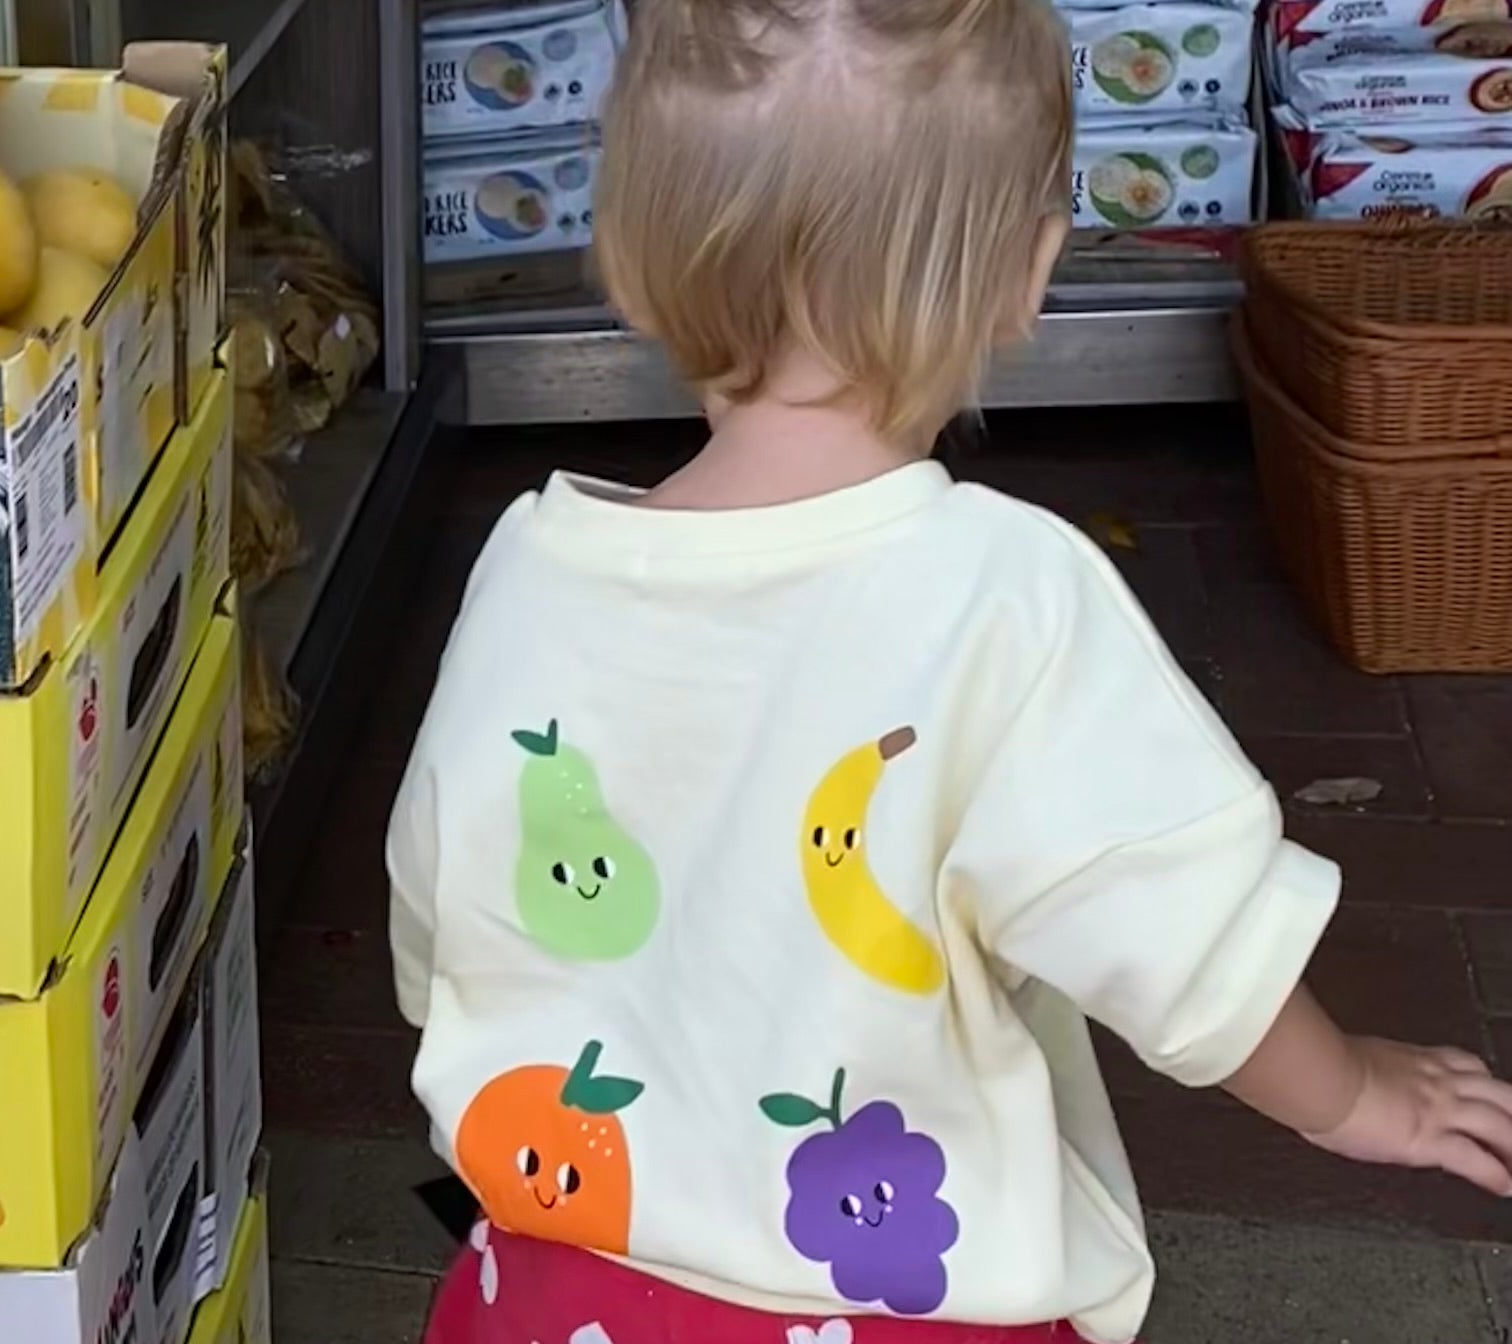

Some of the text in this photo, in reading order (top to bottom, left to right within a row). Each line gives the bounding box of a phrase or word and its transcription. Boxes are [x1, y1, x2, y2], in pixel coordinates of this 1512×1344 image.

[426, 61, 457, 81] RICE
[1371, 96, 1418, 109] BROWN
[1422, 94, 1450, 107] RICE
[435, 191, 469, 212] RICE
